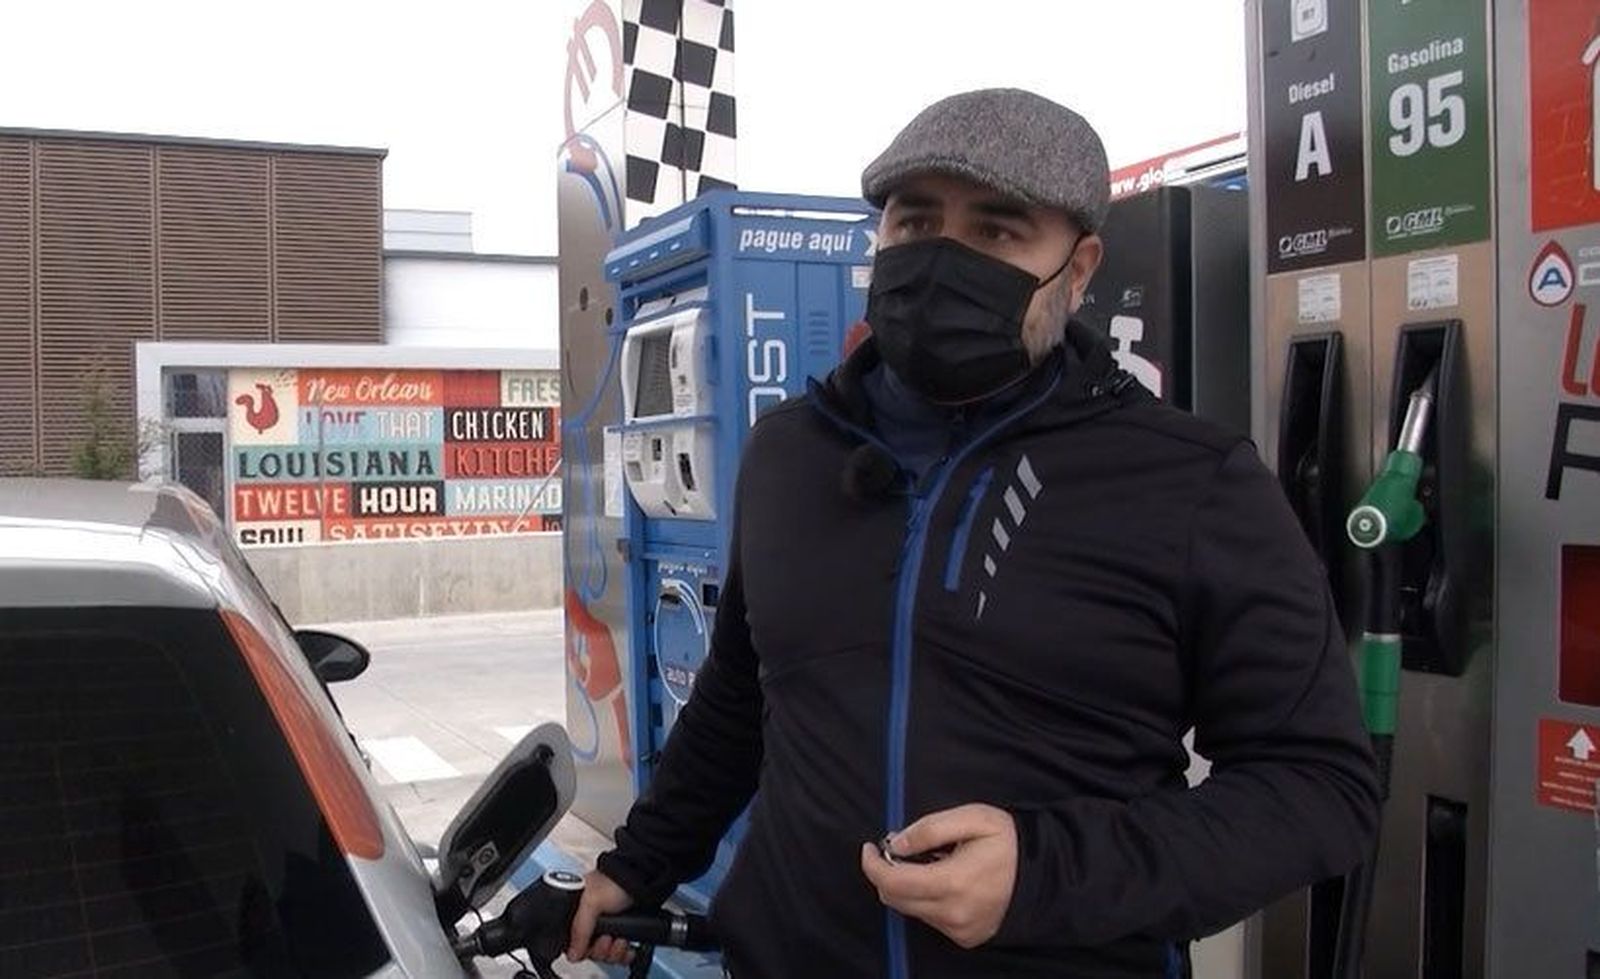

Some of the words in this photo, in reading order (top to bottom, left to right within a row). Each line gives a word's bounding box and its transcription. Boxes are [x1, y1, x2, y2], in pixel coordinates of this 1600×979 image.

[1387, 38, 1465, 74] Gasolina
[1288, 73, 1336, 104] Diesel
[1388, 70, 1467, 157] 95
[1294, 111, 1333, 181] A
[739, 229, 803, 252] pague
[808, 230, 854, 256] aquí
[306, 377, 351, 402] New
[376, 410, 434, 439] THAT
[452, 410, 545, 440] CHICKEN
[238, 451, 436, 479] LOUISIANA
[237, 487, 347, 517] TWELVE
[360, 486, 437, 514] HOUR
